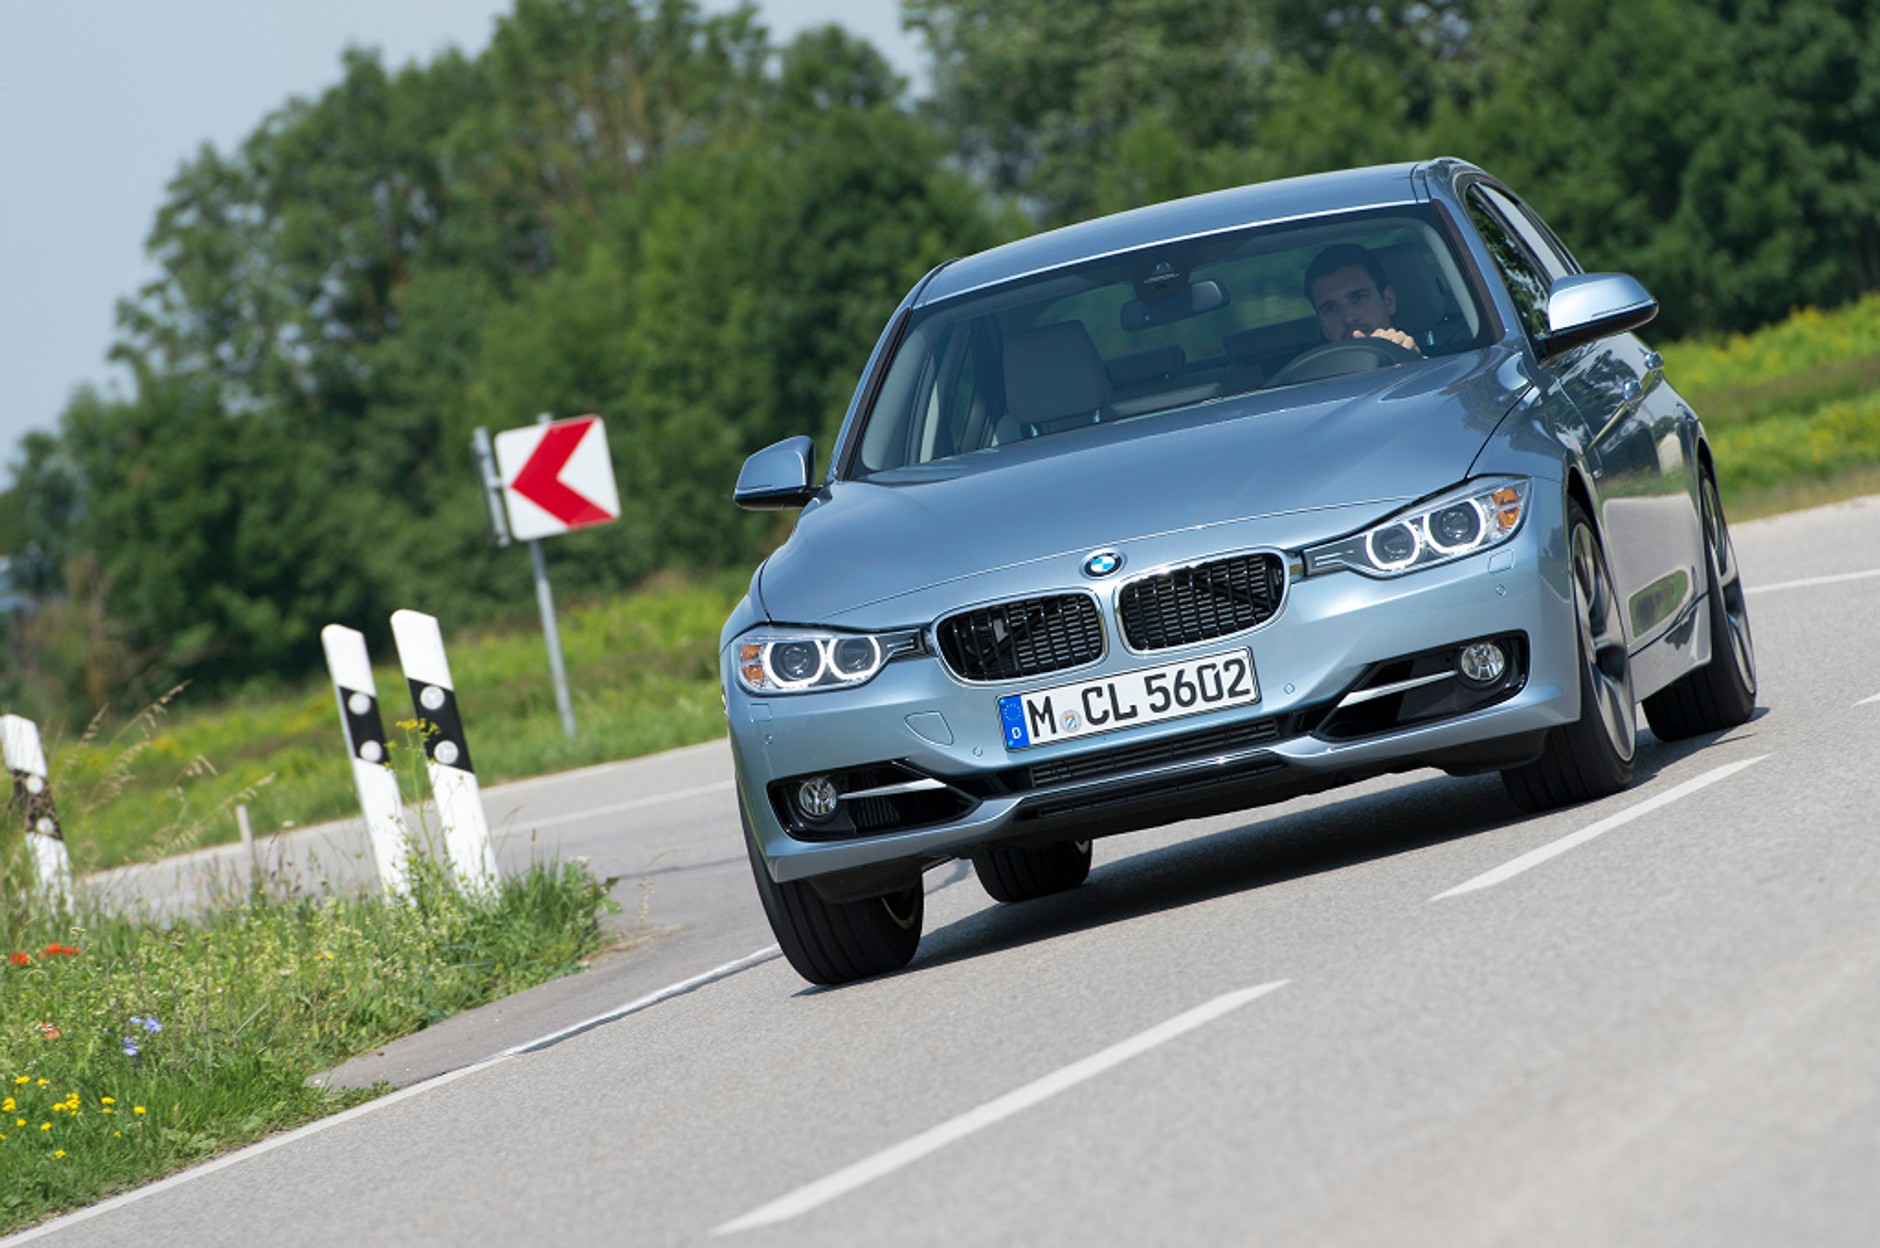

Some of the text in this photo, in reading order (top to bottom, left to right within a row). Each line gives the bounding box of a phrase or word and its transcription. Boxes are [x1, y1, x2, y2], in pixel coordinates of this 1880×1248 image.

[1026, 658, 1250, 737] M CL 5602
[1011, 726, 1022, 739] D
